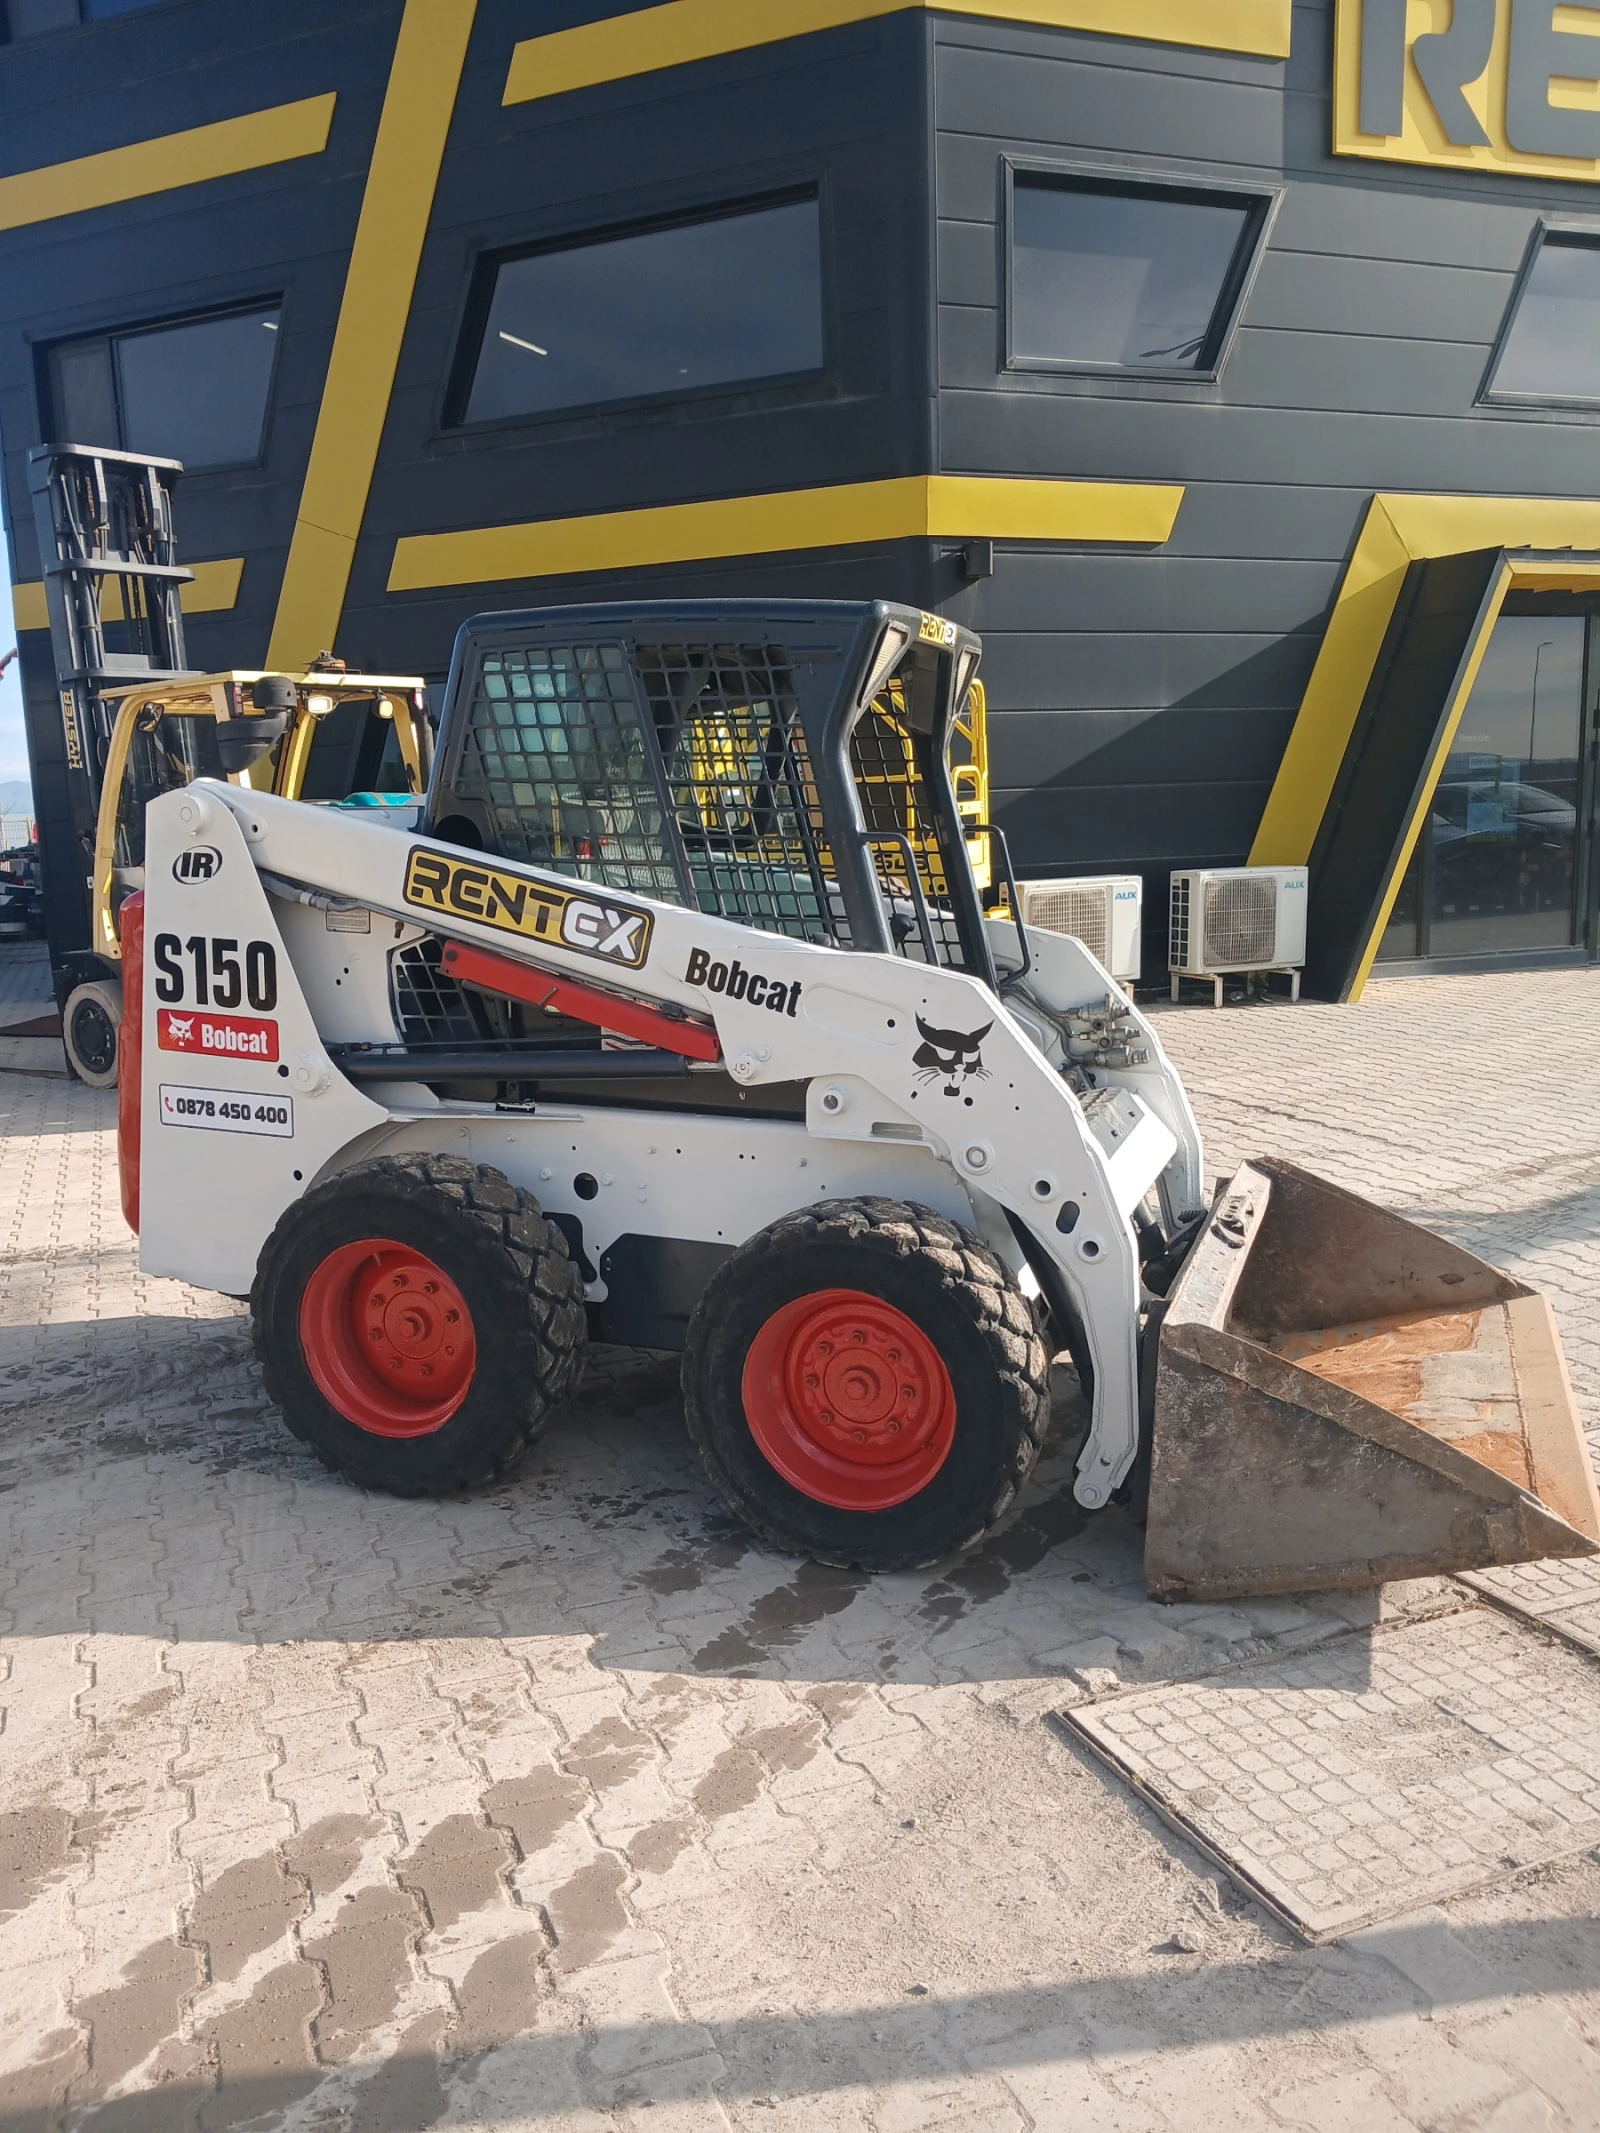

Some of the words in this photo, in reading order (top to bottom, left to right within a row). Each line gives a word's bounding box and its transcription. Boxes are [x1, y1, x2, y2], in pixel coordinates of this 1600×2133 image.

[61, 690, 82, 769] HYSTER
[180, 851, 214, 878] IR
[1115, 891, 1137, 901] AUX
[1284, 881, 1305, 890] AUX
[410, 856, 643, 960] RENTEX
[154, 932, 278, 1012] S150
[685, 947, 802, 1018] Bobcat
[201, 1023, 269, 1055] Bobcat
[176, 1097, 216, 1117] 0878
[219, 1102, 251, 1121] 450
[254, 1106, 288, 1124] 400
